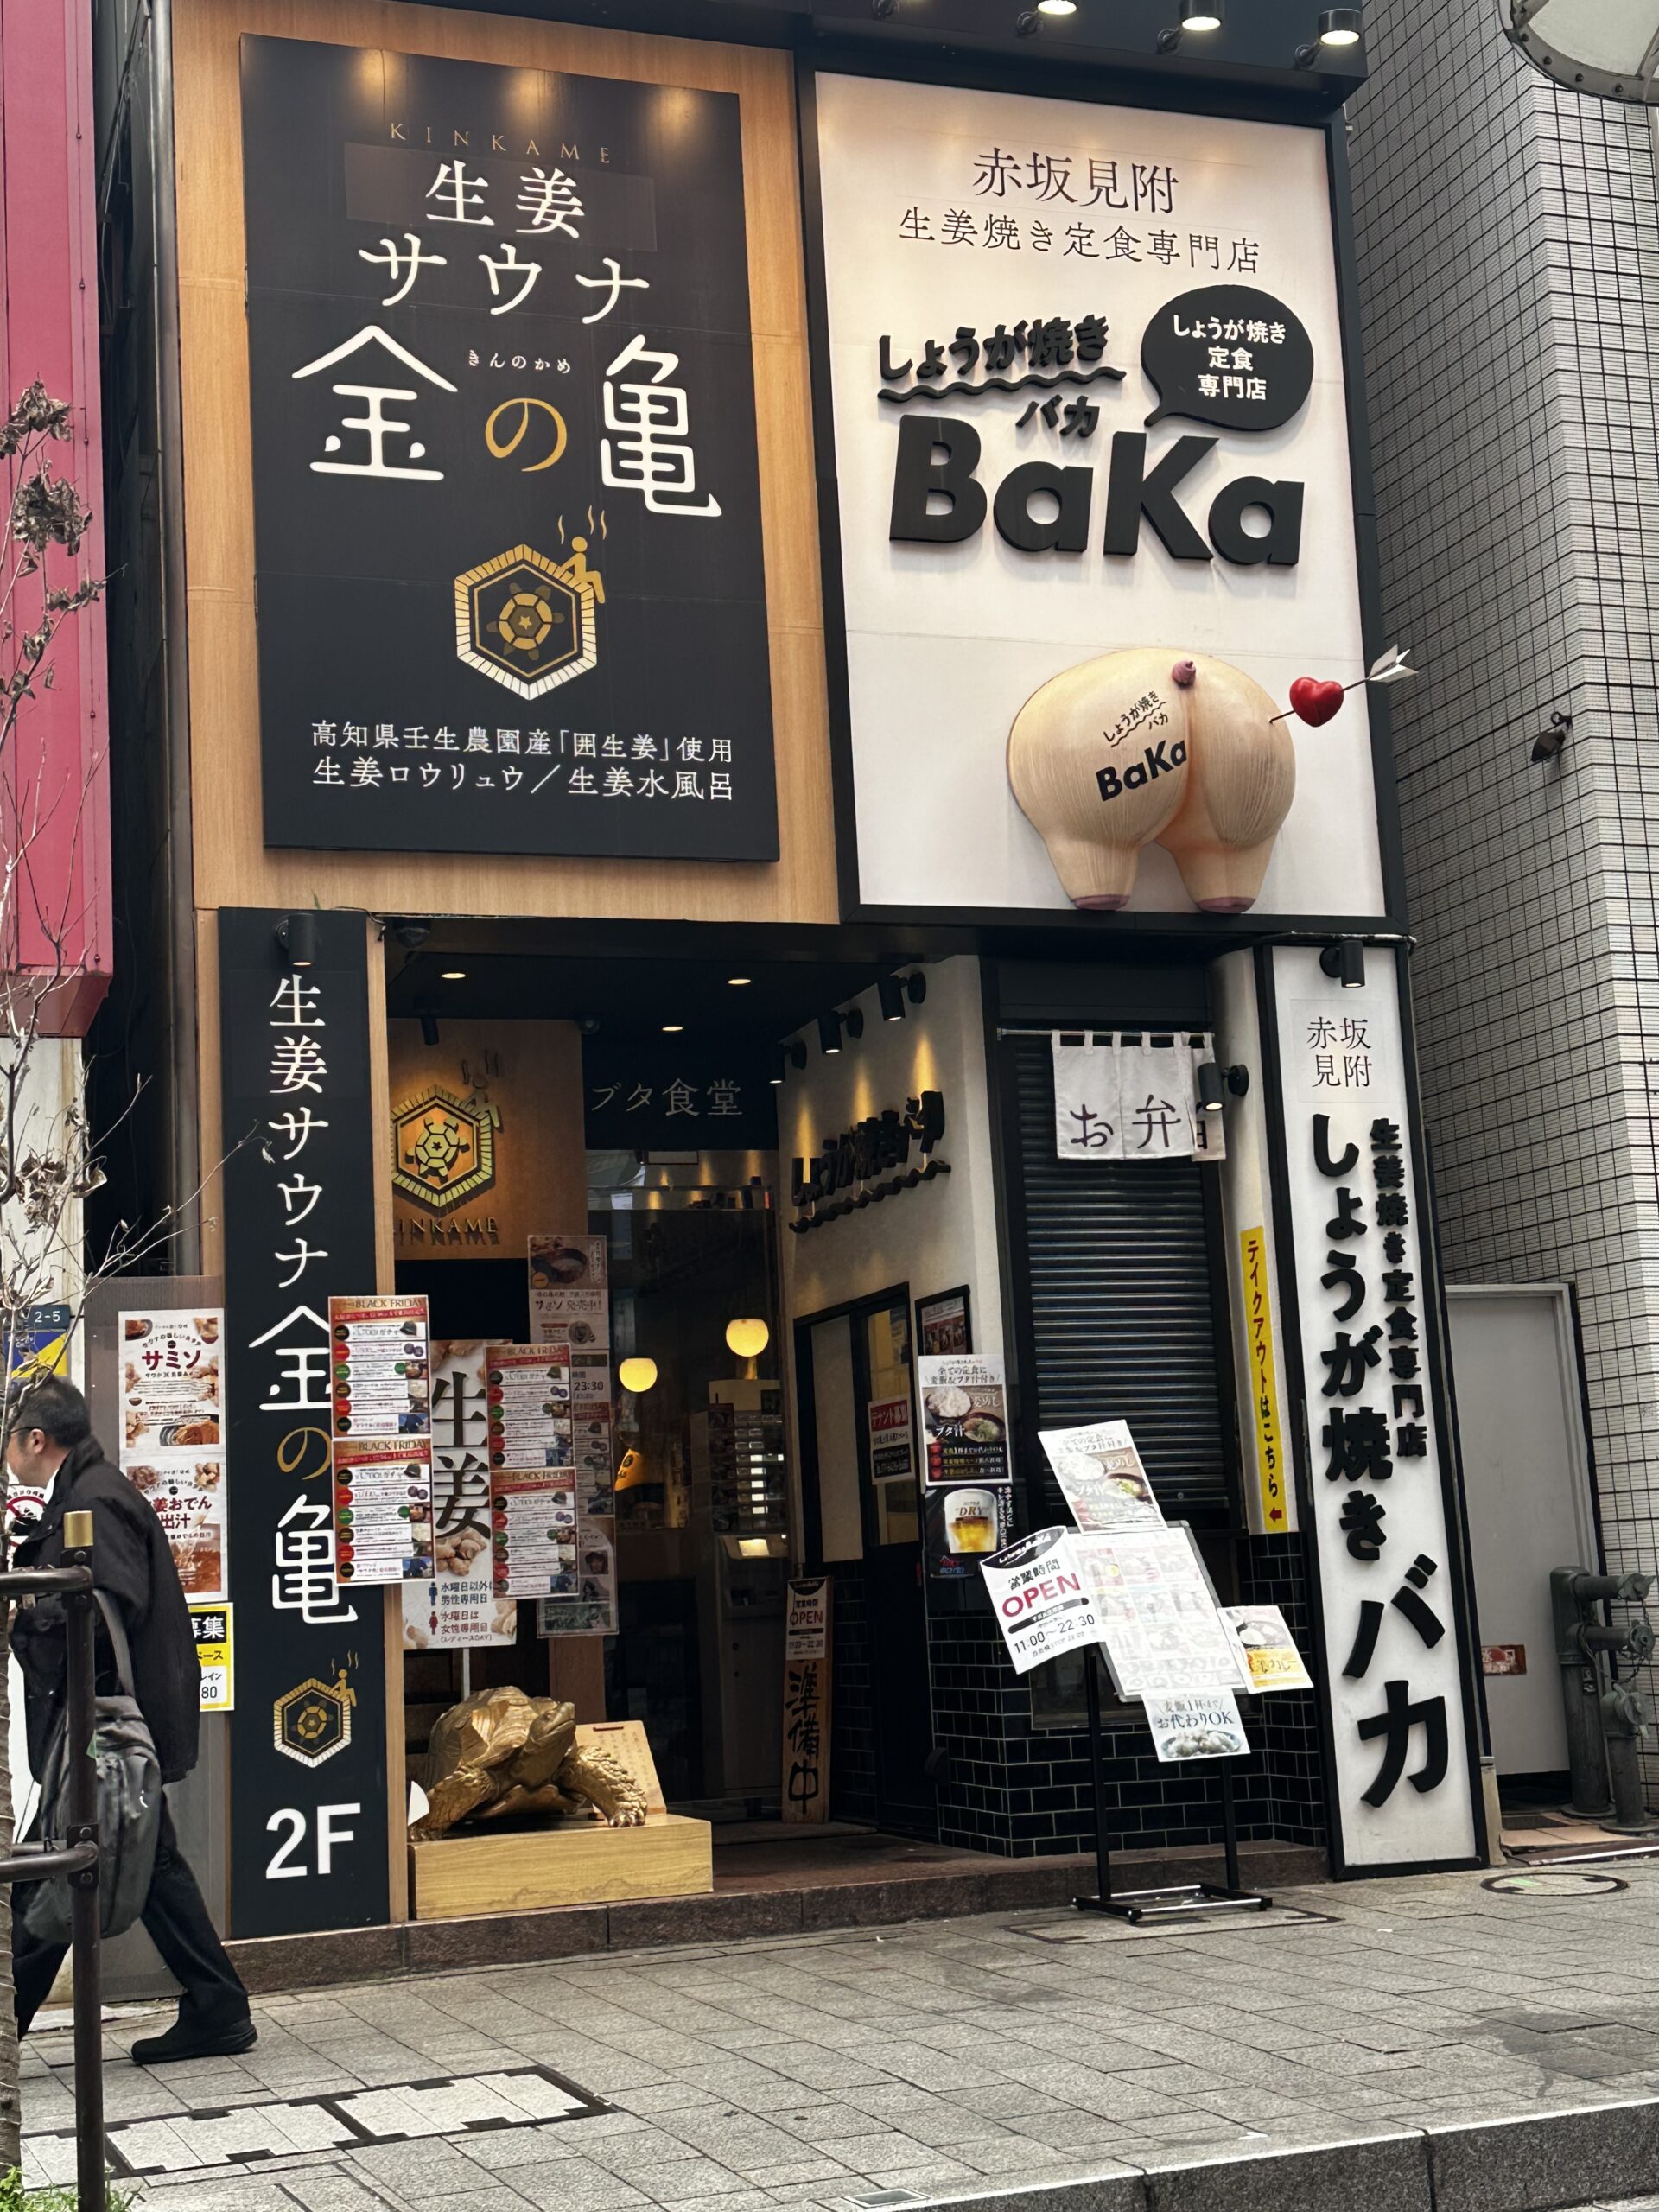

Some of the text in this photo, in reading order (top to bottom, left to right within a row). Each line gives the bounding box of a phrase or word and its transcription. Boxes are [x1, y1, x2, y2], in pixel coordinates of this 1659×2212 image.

[391, 123, 610, 164] KINKAME
[425, 160, 585, 238] 生姜
[973, 148, 1179, 213] 赤坂見附
[899, 207, 1259, 274] 生姜焼き定食専門店
[359, 232, 650, 324] サウナ
[878, 314, 1109, 380] しょうが焼き
[1173, 315, 1286, 343] しょうが焼き
[468, 348, 571, 373] きんのかめ
[1208, 347, 1253, 370] 定食
[1198, 373, 1267, 401] 専門店
[292, 325, 721, 517] 金の亀
[1015, 394, 1099, 436] バカ
[889, 414, 1304, 567] BaKa
[1103, 690, 1160, 742] しょうが焼き
[1148, 713, 1169, 730] バカ
[312, 719, 732, 764] 高知県壬生農園産「囲生姜」使用
[1096, 740, 1188, 802] BaKa
[1307, 1016, 1371, 1051] 赤坂
[1313, 1054, 1372, 1088] 見附
[592, 1077, 742, 1116] ブタ食堂
[268, 974, 329, 1289] 生姜サウナ
[1070, 1094, 1207, 1149] お弁
[393, 1217, 498, 1233] INKAME
[355, 1298, 423, 1308] BLACK FRIDAY
[1370, 1117, 1427, 1458] 生姜焼き定食専門店
[35, 1311, 60, 1323] 2-5
[142, 1350, 201, 1371] サミソ
[1247, 1239, 1279, 1499] テイクアウトはこちら
[249, 1304, 359, 1626] 金の亀
[359, 1440, 428, 1452] BLACK FRIDAY
[432, 1371, 491, 1539] 生姜
[1313, 1114, 1448, 1808] しょうが焼きバカ
[959, 1506, 984, 1516] DRY
[441, 1581, 492, 1592] 水曜日以外
[1002, 1573, 1081, 1618] OPEN
[789, 1610, 823, 1626] OPEN
[201, 1686, 218, 1699] 80
[785, 1662, 821, 1815] 準備中
[1157, 1711, 1235, 1729] お代わりOK
[265, 1802, 361, 1882] 2F
